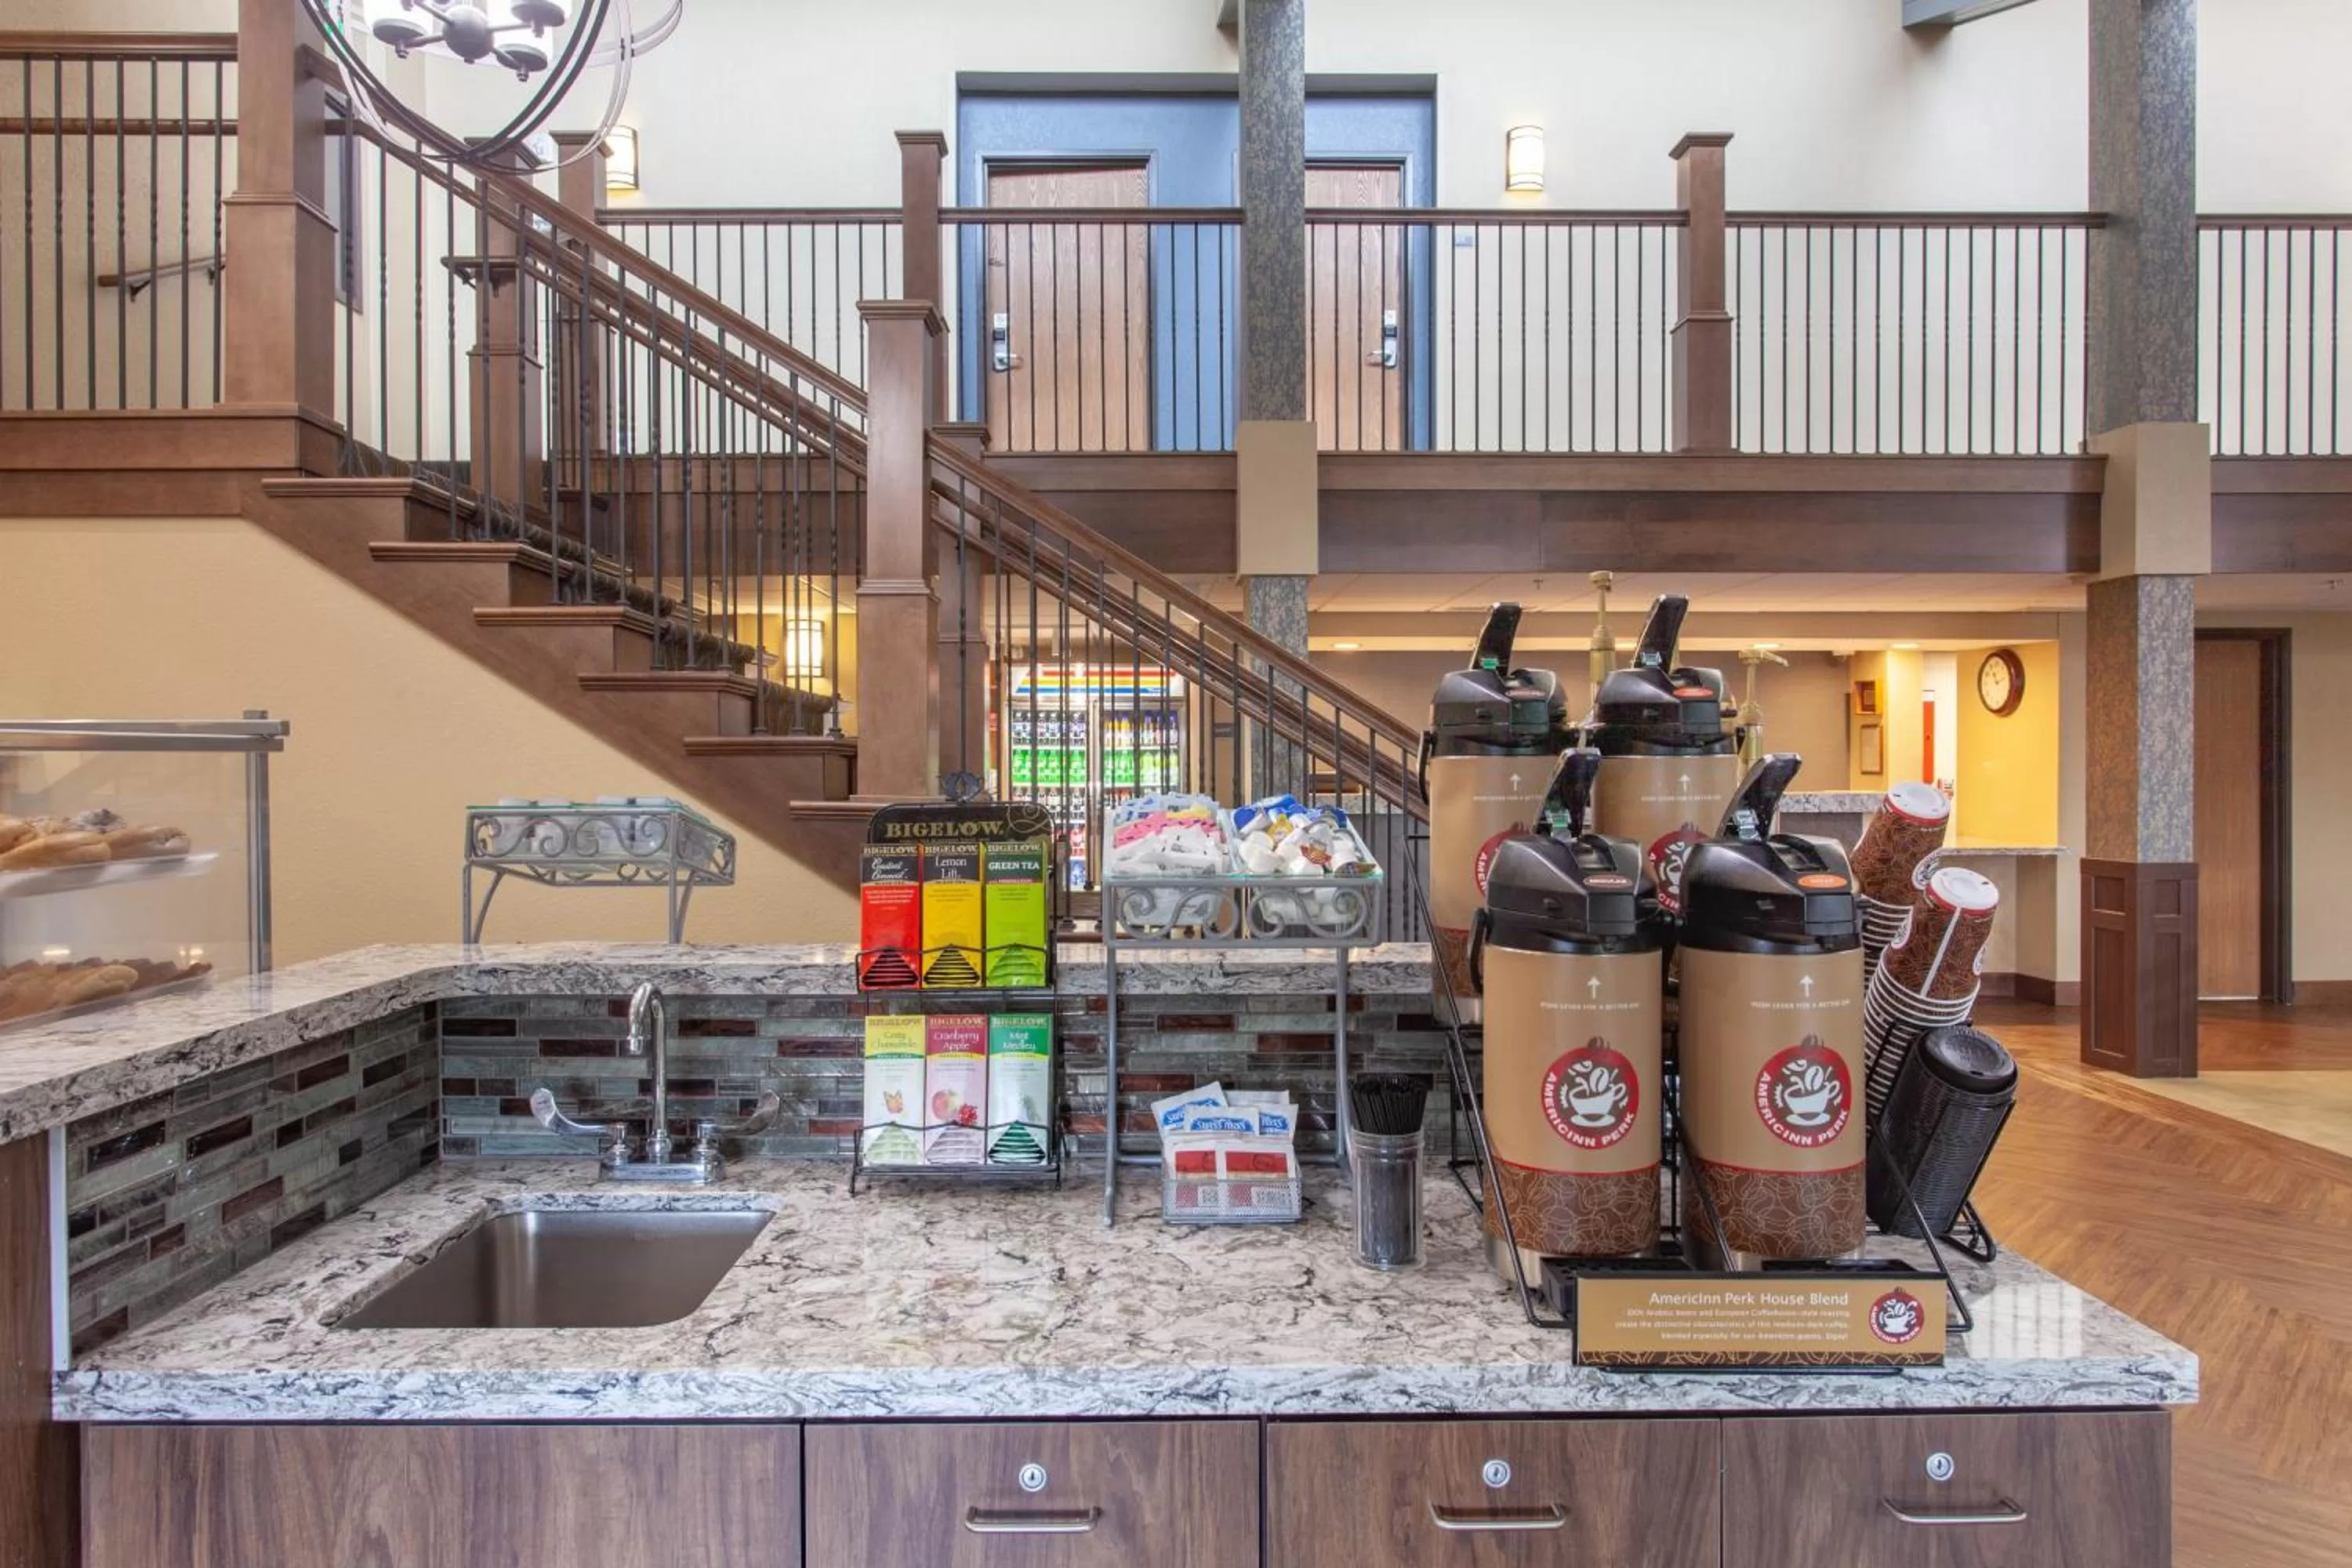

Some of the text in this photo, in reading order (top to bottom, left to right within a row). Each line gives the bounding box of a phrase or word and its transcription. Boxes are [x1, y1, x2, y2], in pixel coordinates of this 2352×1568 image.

[885, 821, 1004, 838] BIGELOW
[988, 861, 1041, 871] GREEN TEA
[1543, 1071, 1635, 1148] AMERICINN PERK
[1757, 1071, 1848, 1146] AMERICINN PERK
[1726, 1292, 1755, 1305] Perk
[1761, 1292, 1804, 1305] House
[1809, 1291, 1849, 1305] Blend
